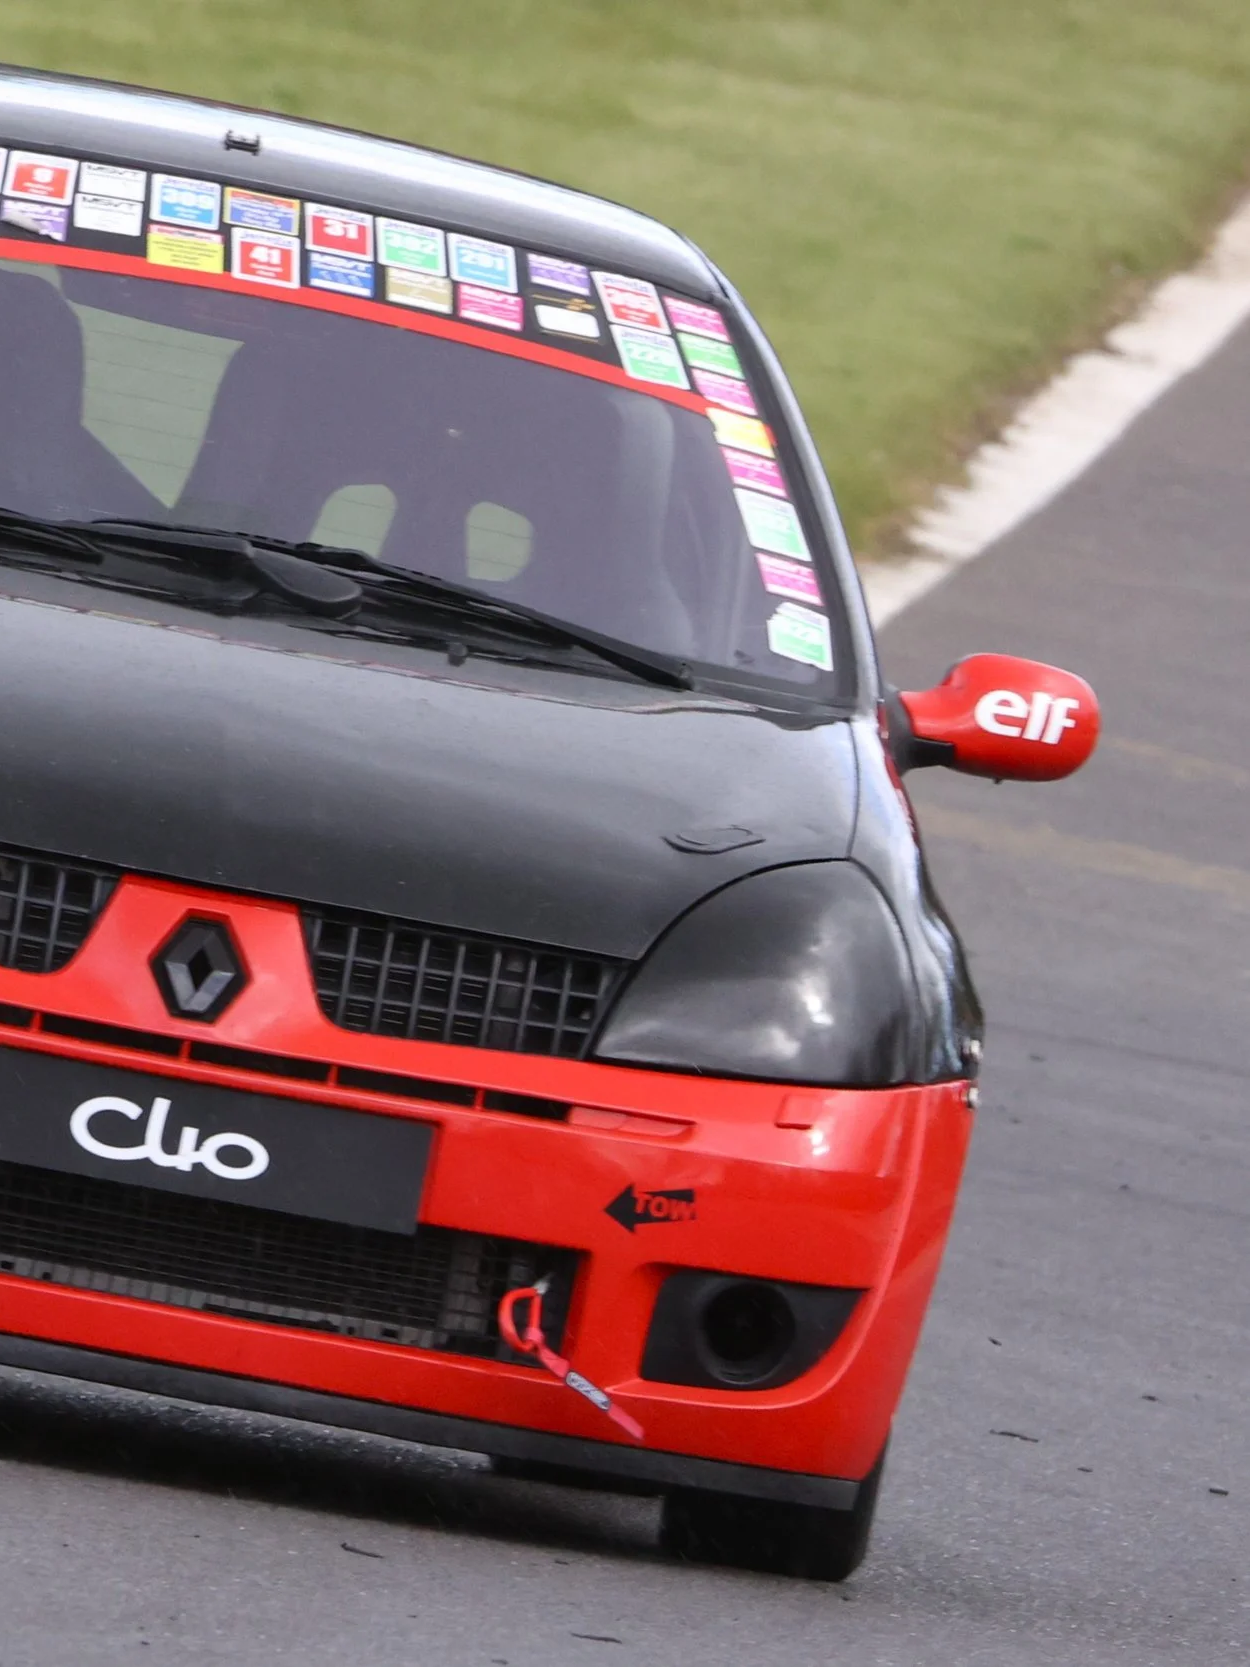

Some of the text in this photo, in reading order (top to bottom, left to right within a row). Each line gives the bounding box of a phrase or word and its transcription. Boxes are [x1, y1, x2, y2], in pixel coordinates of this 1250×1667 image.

[323, 219, 359, 239] 31
[250, 246, 282, 265] 41
[974, 689, 1080, 745] elf
[70, 1096, 270, 1180] Clio
